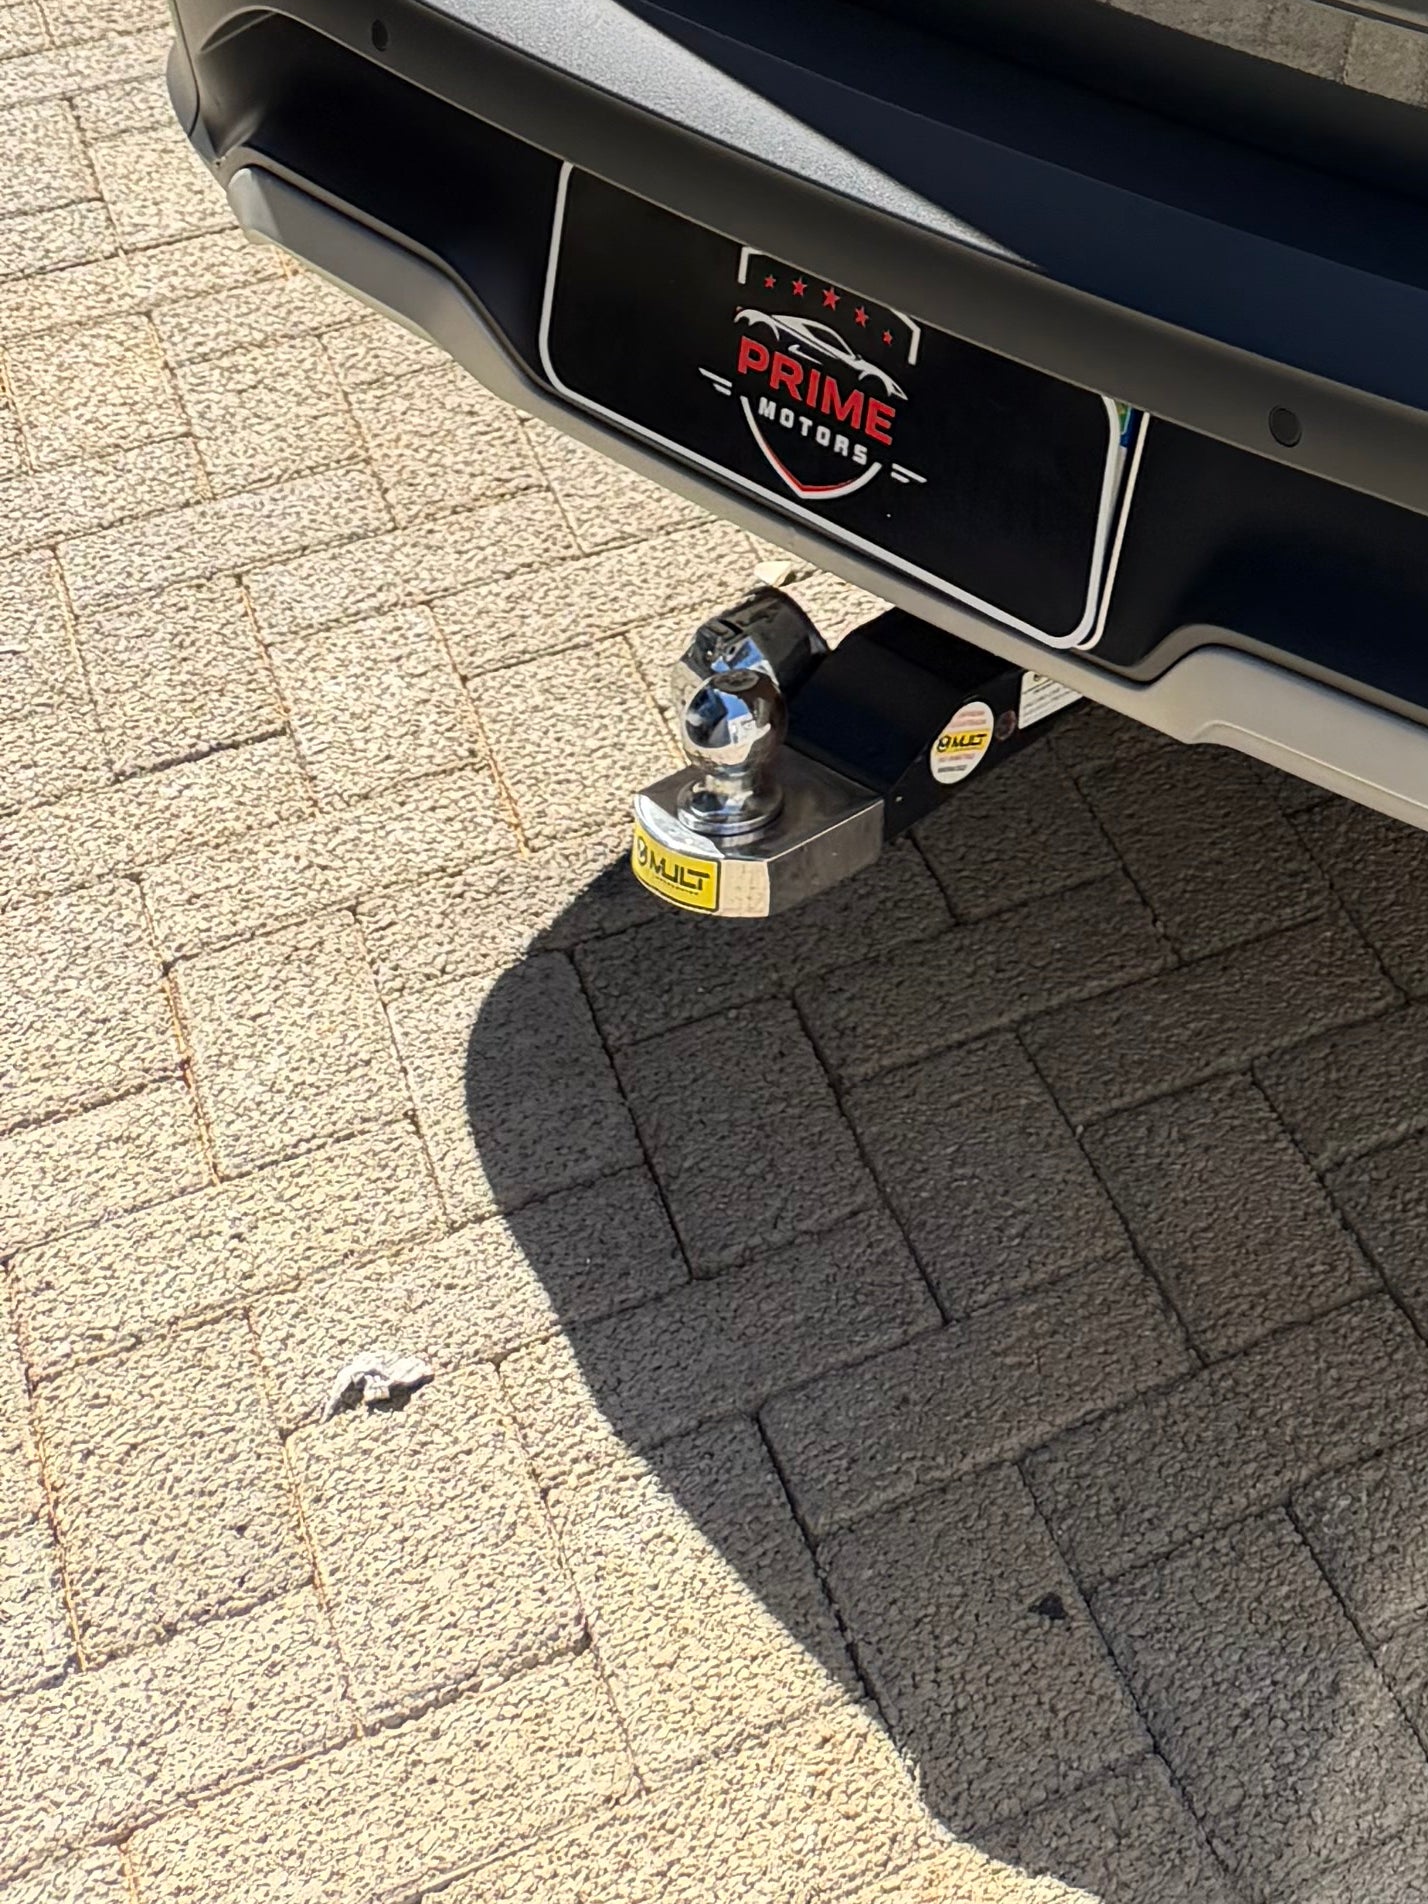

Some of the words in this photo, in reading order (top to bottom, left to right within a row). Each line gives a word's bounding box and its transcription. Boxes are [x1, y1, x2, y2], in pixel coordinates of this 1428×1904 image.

[737, 335, 896, 446] PRIME
[758, 396, 868, 465] MOTORS
[650, 850, 710, 891] MULT
